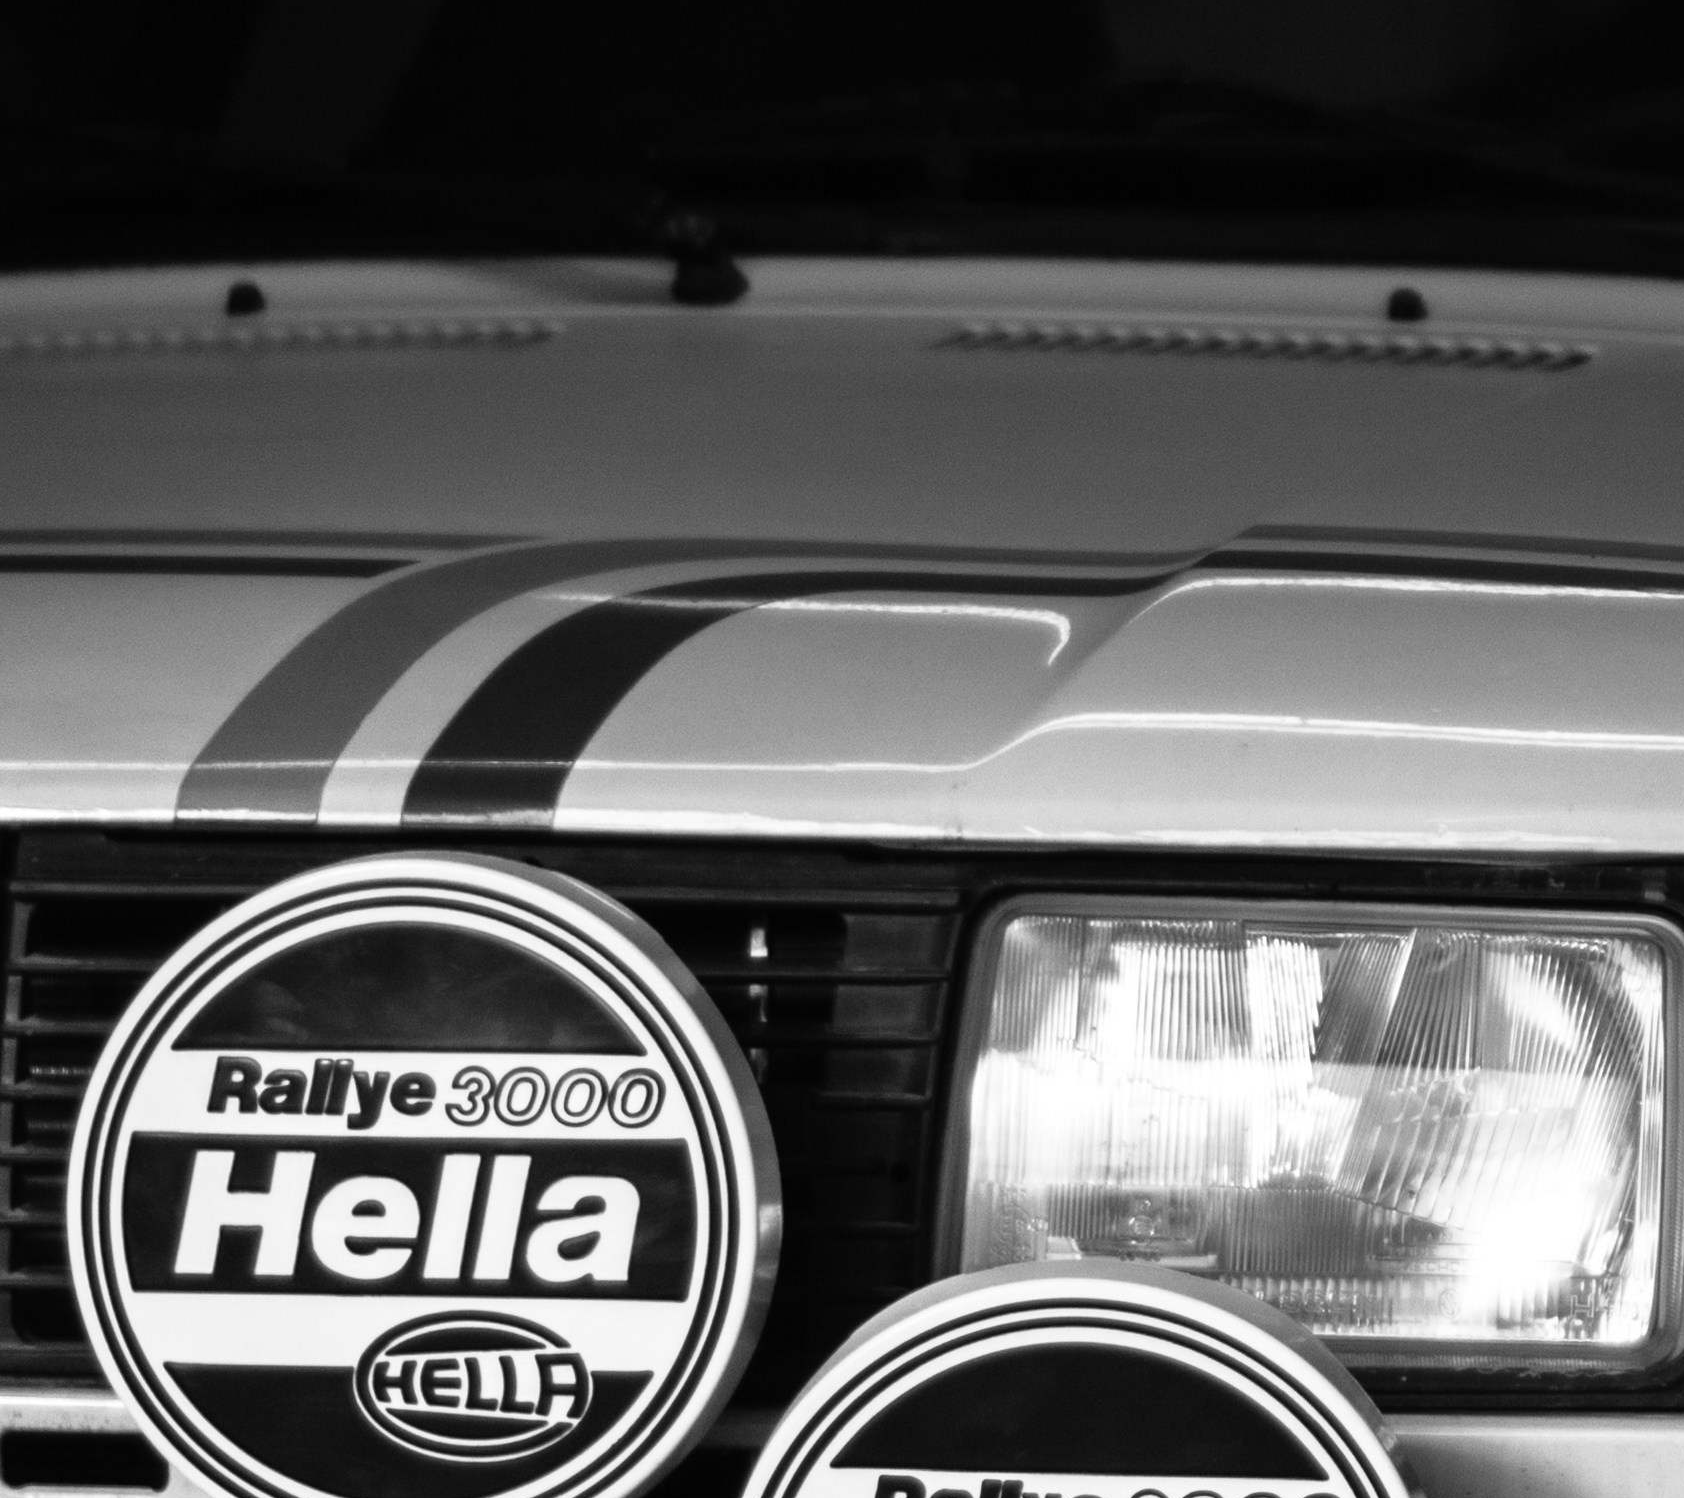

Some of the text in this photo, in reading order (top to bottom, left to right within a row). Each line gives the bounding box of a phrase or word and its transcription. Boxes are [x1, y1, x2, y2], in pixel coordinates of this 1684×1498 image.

[206, 1056, 667, 1130] Rallye 3000
[174, 1150, 641, 1284] Hella
[373, 1351, 590, 1421] HELLA
